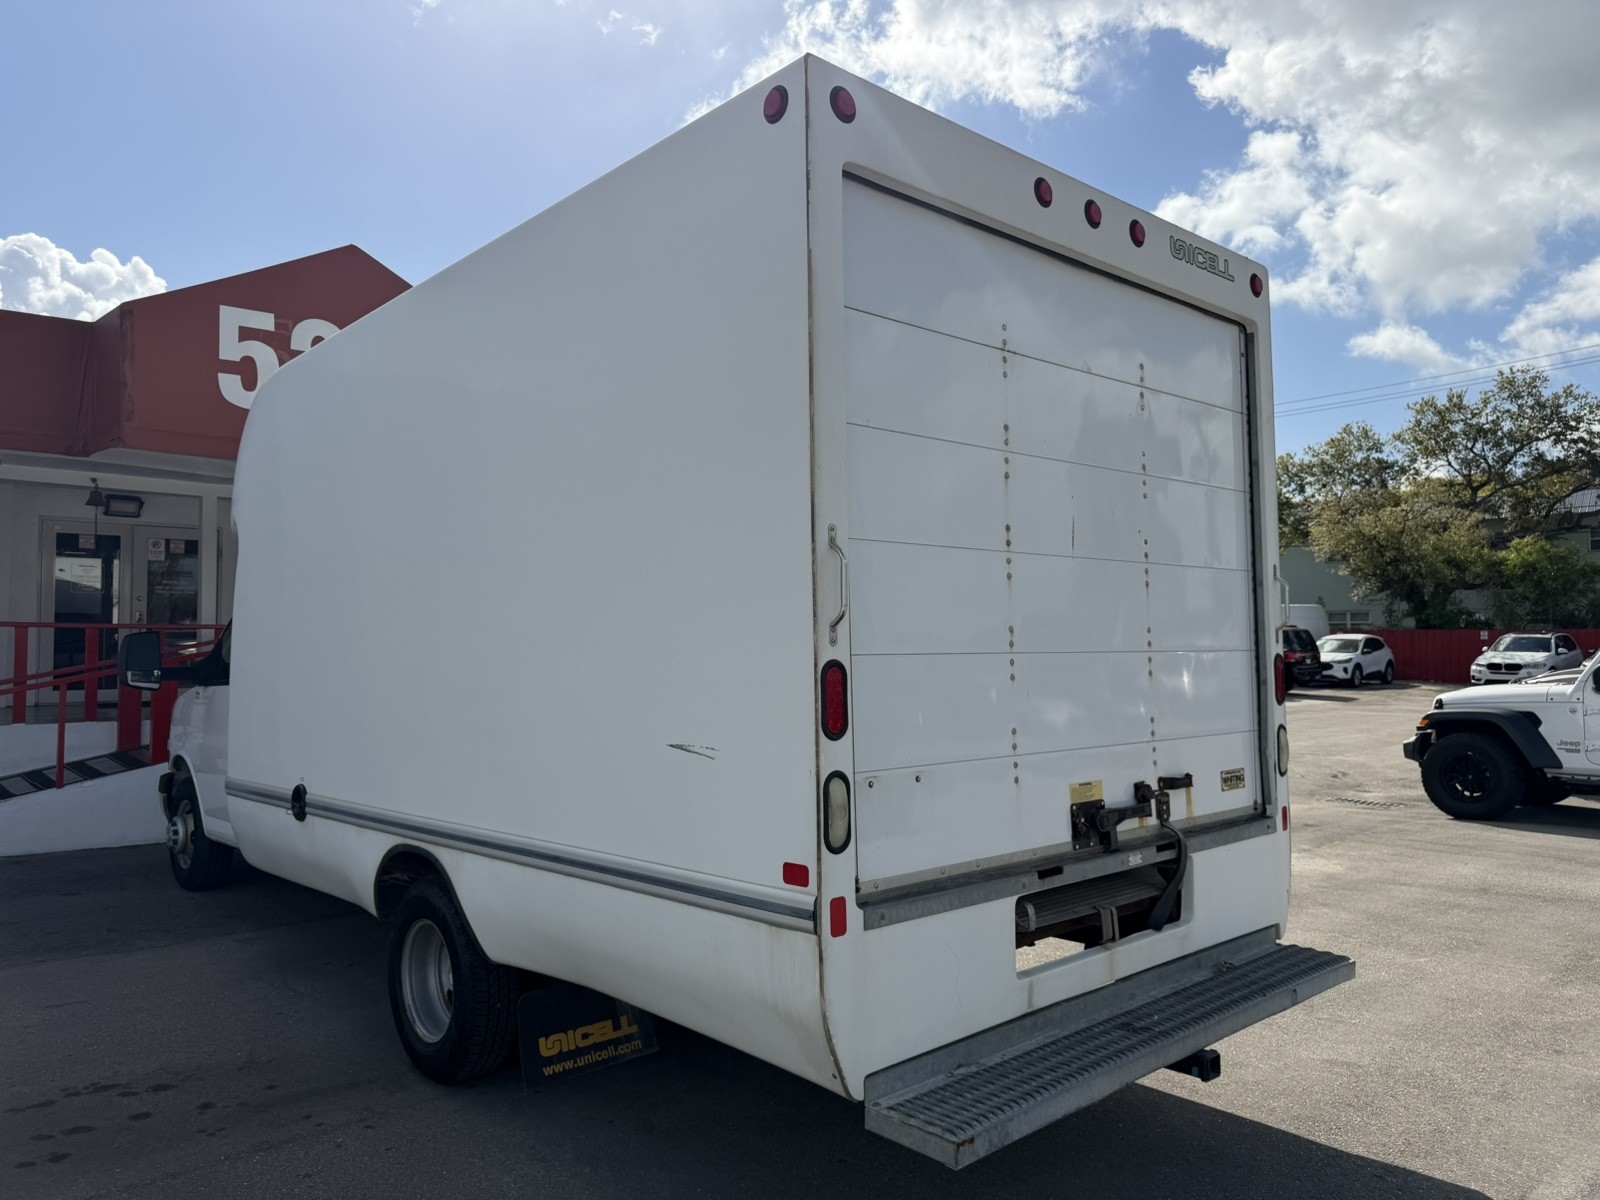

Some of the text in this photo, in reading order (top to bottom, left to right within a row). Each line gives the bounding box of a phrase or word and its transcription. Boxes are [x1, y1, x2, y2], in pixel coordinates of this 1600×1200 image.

[1169, 235, 1235, 283] UNICELL
[1556, 739, 1581, 748] Jeep
[538, 1014, 639, 1058] UNICELL
[542, 1039, 642, 1077] www.unicell.com
